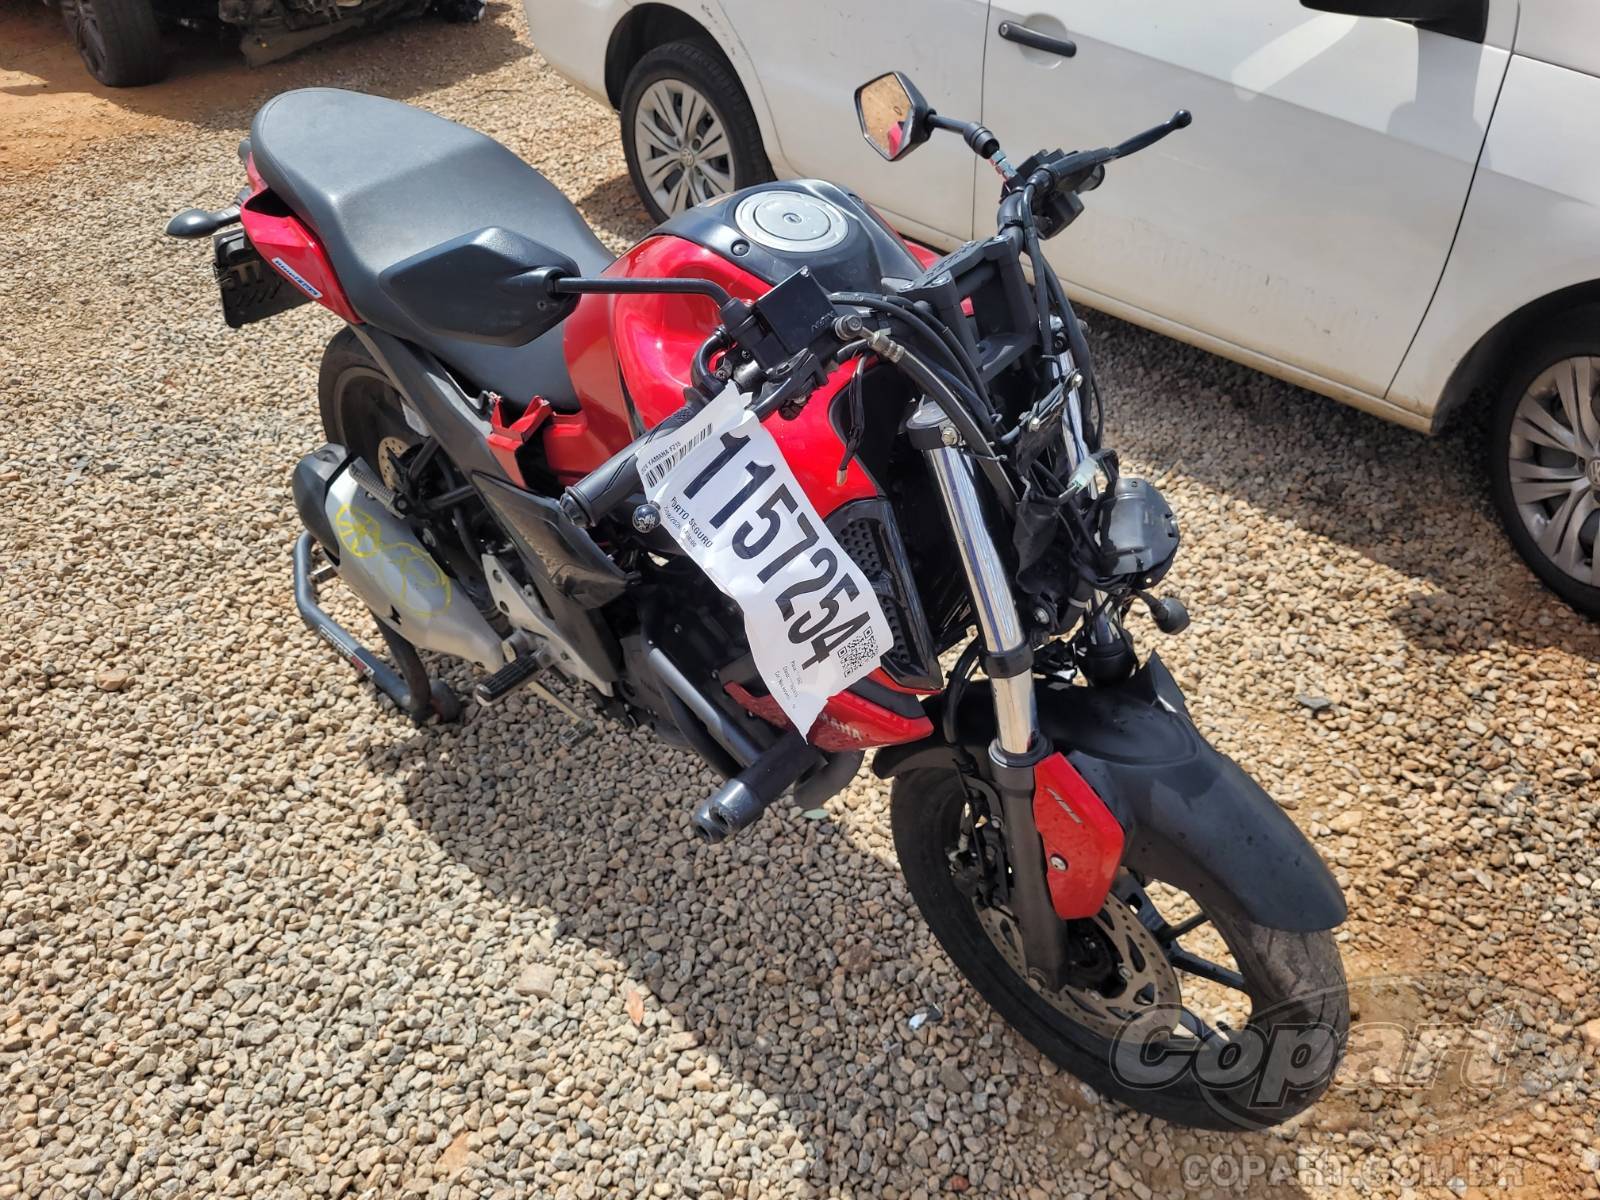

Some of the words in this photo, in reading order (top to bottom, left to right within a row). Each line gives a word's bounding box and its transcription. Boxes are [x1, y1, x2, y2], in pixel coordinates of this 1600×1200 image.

[671, 496, 690, 519] PORTO
[688, 518, 713, 548] SEGURO
[683, 432, 870, 671] 1157254
